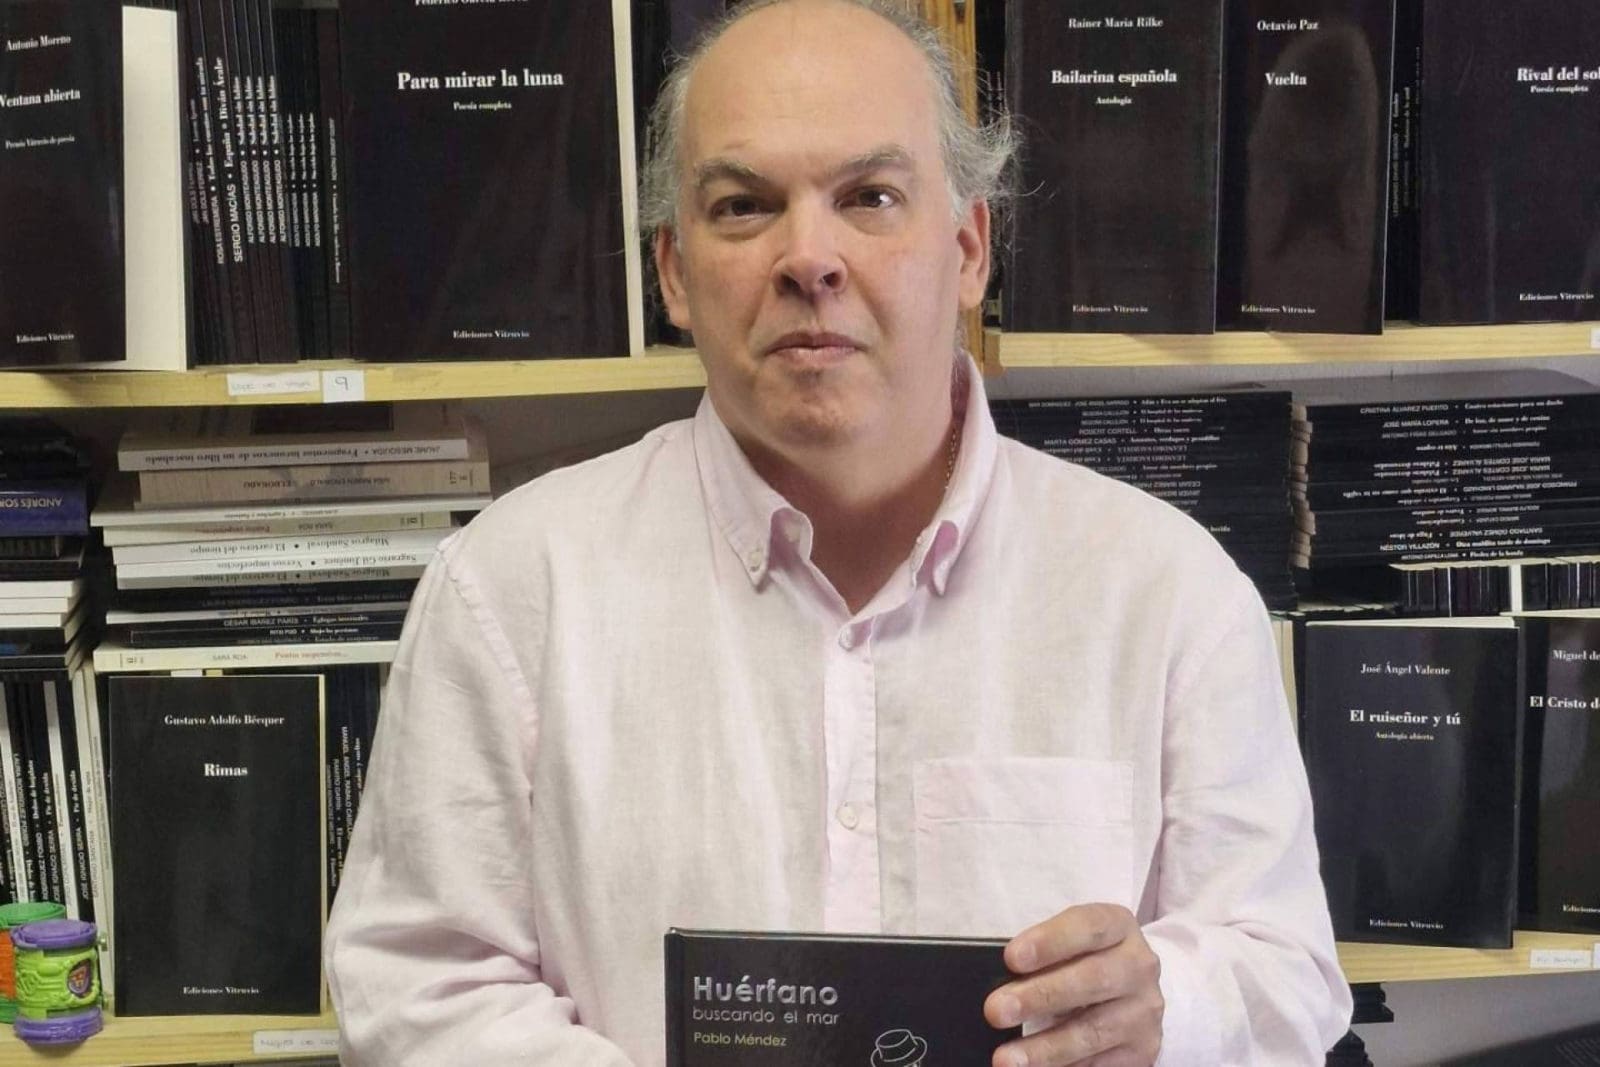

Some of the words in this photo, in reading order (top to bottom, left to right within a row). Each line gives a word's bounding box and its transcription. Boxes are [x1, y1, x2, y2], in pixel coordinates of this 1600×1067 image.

[1068, 18, 1102, 29] Rainer
[1105, 17, 1133, 28] Maria
[1136, 16, 1163, 28] Rilke
[1256, 20, 1297, 32] Octavio
[1299, 19, 1319, 31] Paz
[6, 39, 39, 51] Antonio
[40, 35, 72, 47] Moreno
[213, 57, 225, 87] Árabe
[1517, 67, 1553, 81] Rival
[1557, 66, 1579, 81] del
[397, 72, 440, 90] Para
[445, 71, 496, 88] mirar
[501, 69, 518, 87] la
[523, 68, 565, 86] luna
[1051, 69, 1115, 85] Bailarina
[1118, 68, 1177, 88] española
[1265, 72, 1307, 87] Vuelta
[1530, 85, 1555, 94] Poesía
[1555, 85, 1589, 95] completa
[0, 93, 41, 108] Ventana
[44, 88, 81, 104] abierta
[1095, 96, 1132, 106] Antología
[218, 90, 228, 120] Diván
[453, 101, 478, 111] Poesía
[478, 99, 512, 113] completa
[223, 131, 234, 168] España
[227, 183, 239, 223] MACÍAS
[231, 223, 243, 263] SERGIO
[1519, 292, 1557, 302] Ediciones
[1559, 291, 1594, 301] Vitruvio
[1072, 303, 1111, 313] Ediciones
[1113, 304, 1148, 313] Vitruvio
[1241, 304, 1280, 314] Ediciones
[1281, 305, 1316, 314] Vitruvio
[453, 330, 493, 339] Ediciones
[494, 329, 530, 339] Vitruvio
[303, 447, 358, 459] Fragmentos
[372, 446, 413, 456] MESQUIDA
[414, 446, 441, 455] JAUME
[145, 454, 194, 465] inacabado
[197, 454, 220, 463] libro
[223, 453, 235, 461] un
[238, 452, 249, 461] de
[20, 495, 63, 510] ANDRÉS
[239, 543, 274, 552] cartero
[274, 543, 286, 552] El
[307, 540, 350, 550] Sandoval
[350, 537, 389, 547] Milagros
[1380, 543, 1408, 551] NÉSTOR
[1408, 542, 1440, 550] VILLAZÓN
[190, 545, 222, 555] tiempo
[223, 546, 238, 555] del
[324, 557, 361, 566] Jiménez
[362, 557, 377, 566] Gil
[379, 553, 417, 563] Sagrario
[217, 560, 270, 571] imperfectos
[271, 560, 303, 569] Versos
[1553, 649, 1587, 662] Miguel
[1589, 650, 1600, 660] de
[1360, 663, 1381, 675] José
[1384, 660, 1412, 676] Ángel
[1414, 664, 1451, 675] Valente
[1530, 695, 1544, 708] El
[1547, 696, 1587, 709] Cristo
[164, 714, 206, 726] Gustavo
[208, 714, 242, 725] Adolfo
[244, 714, 285, 728] Bécquer
[1350, 709, 1365, 722] El
[1369, 710, 1428, 724] ruiseñor
[1432, 715, 1442, 727] y
[1446, 711, 1461, 725] tú
[1408, 731, 1435, 741] abierta
[204, 762, 249, 777] Rimas
[75, 827, 85, 851] SERRA
[78, 851, 87, 881] IGNACIO
[80, 882, 89, 900] JOSÉ
[1563, 904, 1600, 914] Ediciones
[1369, 919, 1408, 929] Ediciones
[1410, 920, 1444, 930] Vitruvio
[182, 986, 224, 995] Ediciones
[224, 986, 259, 995] Vitruvio
[693, 974, 839, 1007] Huérfano
[693, 1007, 775, 1024] buscando
[783, 1008, 798, 1024] el
[806, 1012, 839, 1026] mar
[693, 1031, 731, 1046] Pablo
[734, 1032, 787, 1048] Méndez
